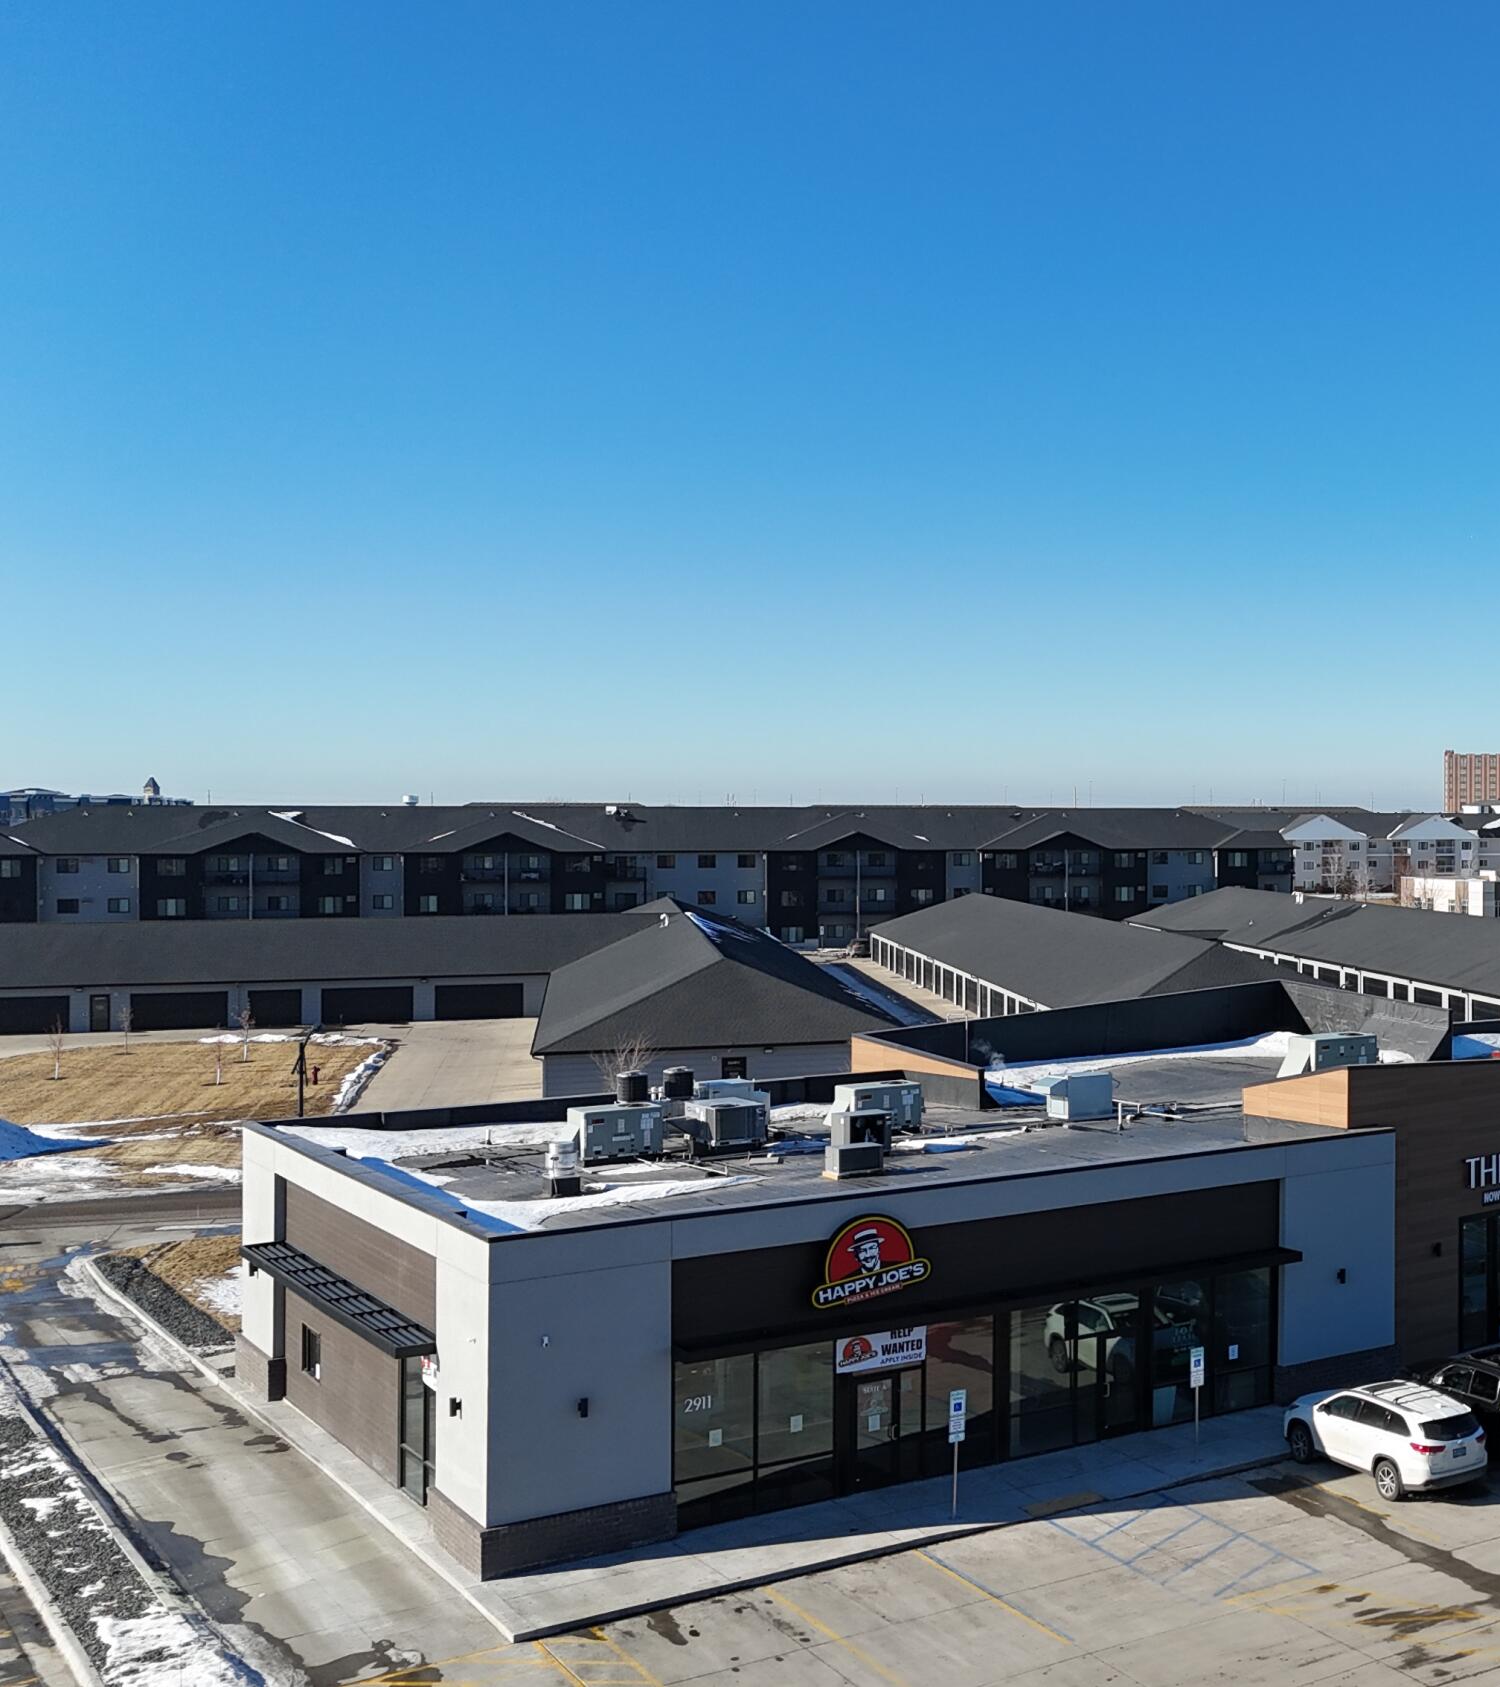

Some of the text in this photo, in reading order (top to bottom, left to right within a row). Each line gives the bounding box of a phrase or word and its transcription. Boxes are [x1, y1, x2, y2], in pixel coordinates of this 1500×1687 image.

[1483, 1190, 1500, 1203] NOW
[819, 1263, 925, 1303] HAPPY JOE'S
[881, 1339, 922, 1356] WANTED
[881, 1352, 922, 1365] APPLY INSIDE
[684, 1395, 711, 1413] 2911
